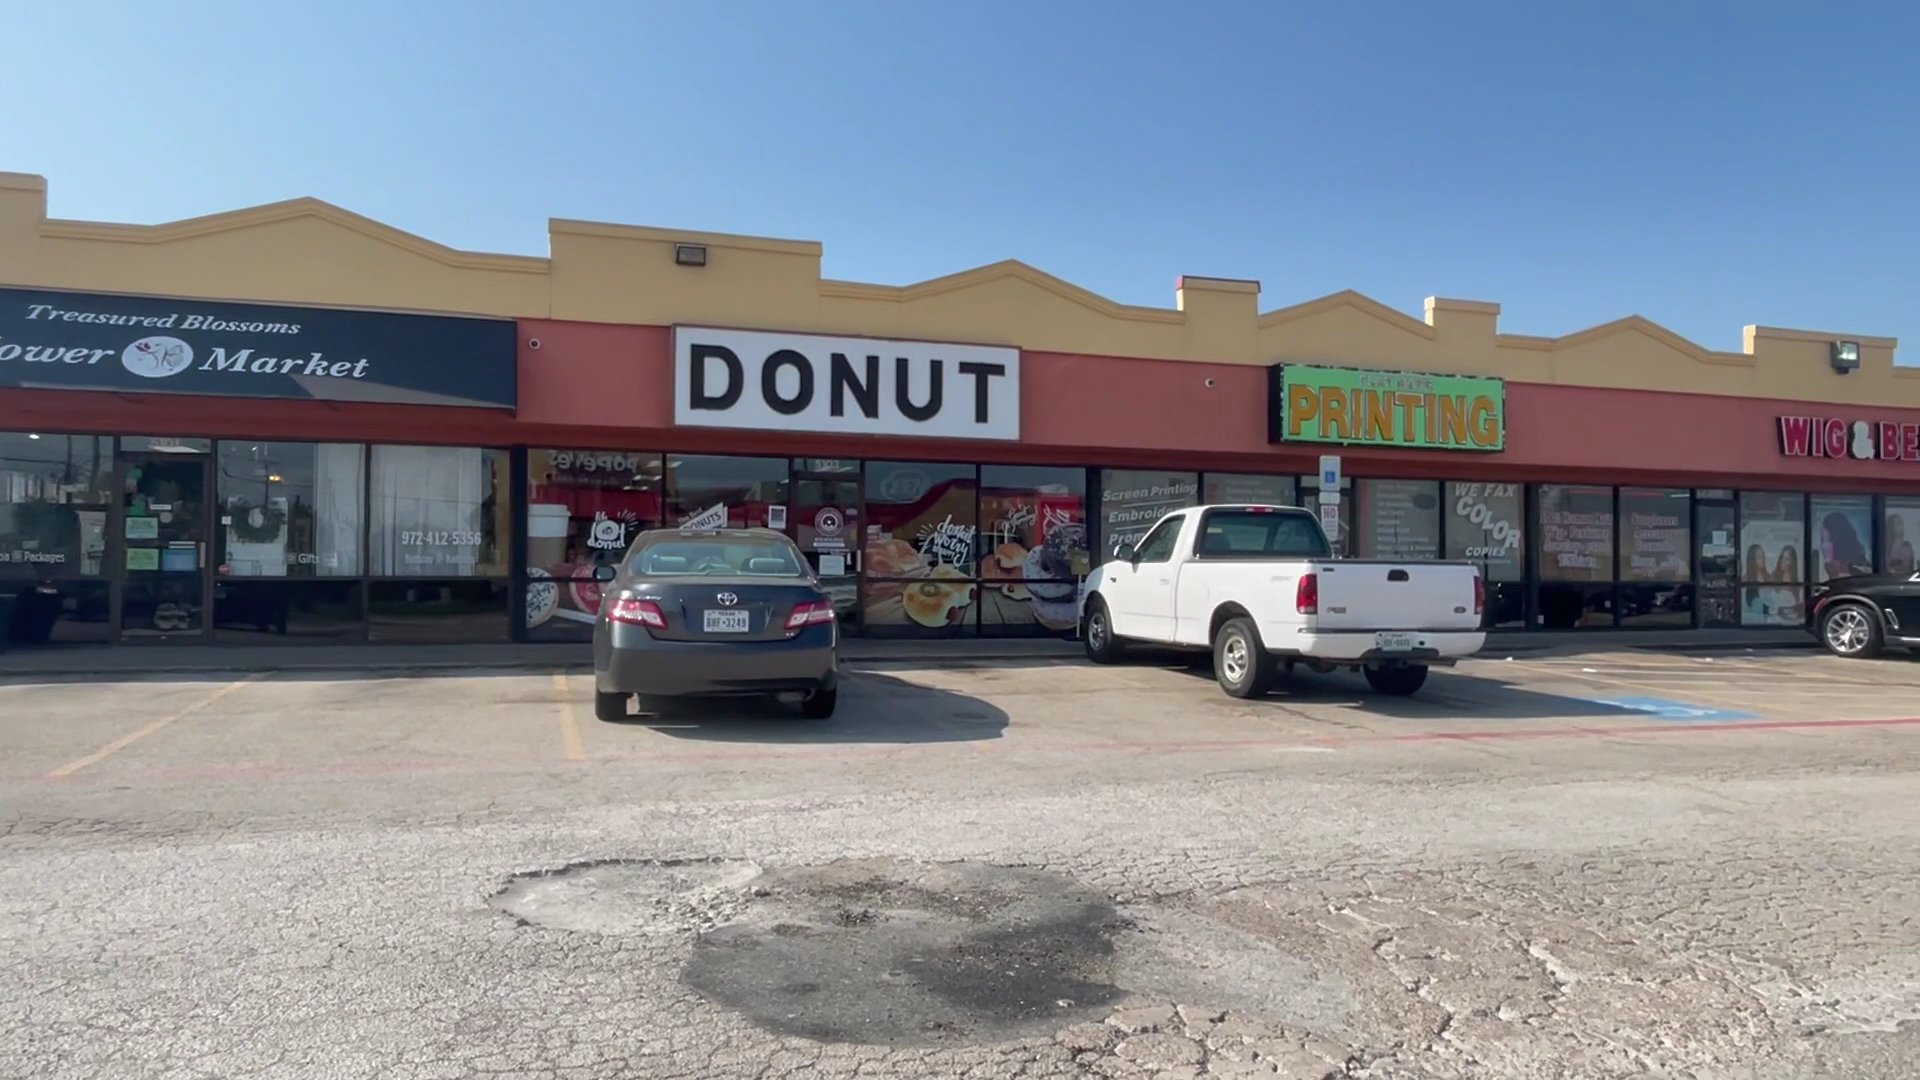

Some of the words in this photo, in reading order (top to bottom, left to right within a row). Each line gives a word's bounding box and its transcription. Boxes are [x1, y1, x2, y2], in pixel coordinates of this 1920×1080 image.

[26, 304, 178, 328] Treasured
[180, 314, 301, 334] Blossoms
[0, 336, 116, 364] ower
[199, 347, 370, 378] Market
[690, 343, 1005, 423] DONUT
[1288, 383, 1499, 446] PRINTING
[1780, 415, 1847, 458] WIG
[1852, 421, 1875, 459] &
[1879, 421, 1920, 461] BE
[1102, 488, 1148, 501] Screen
[1150, 482, 1198, 497] Printing
[1455, 483, 1479, 496] WE
[1484, 484, 1517, 497] FAX
[682, 512, 721, 529] ONUTS
[1456, 496, 1521, 548] COLOR
[1465, 547, 1506, 557] COPIES
